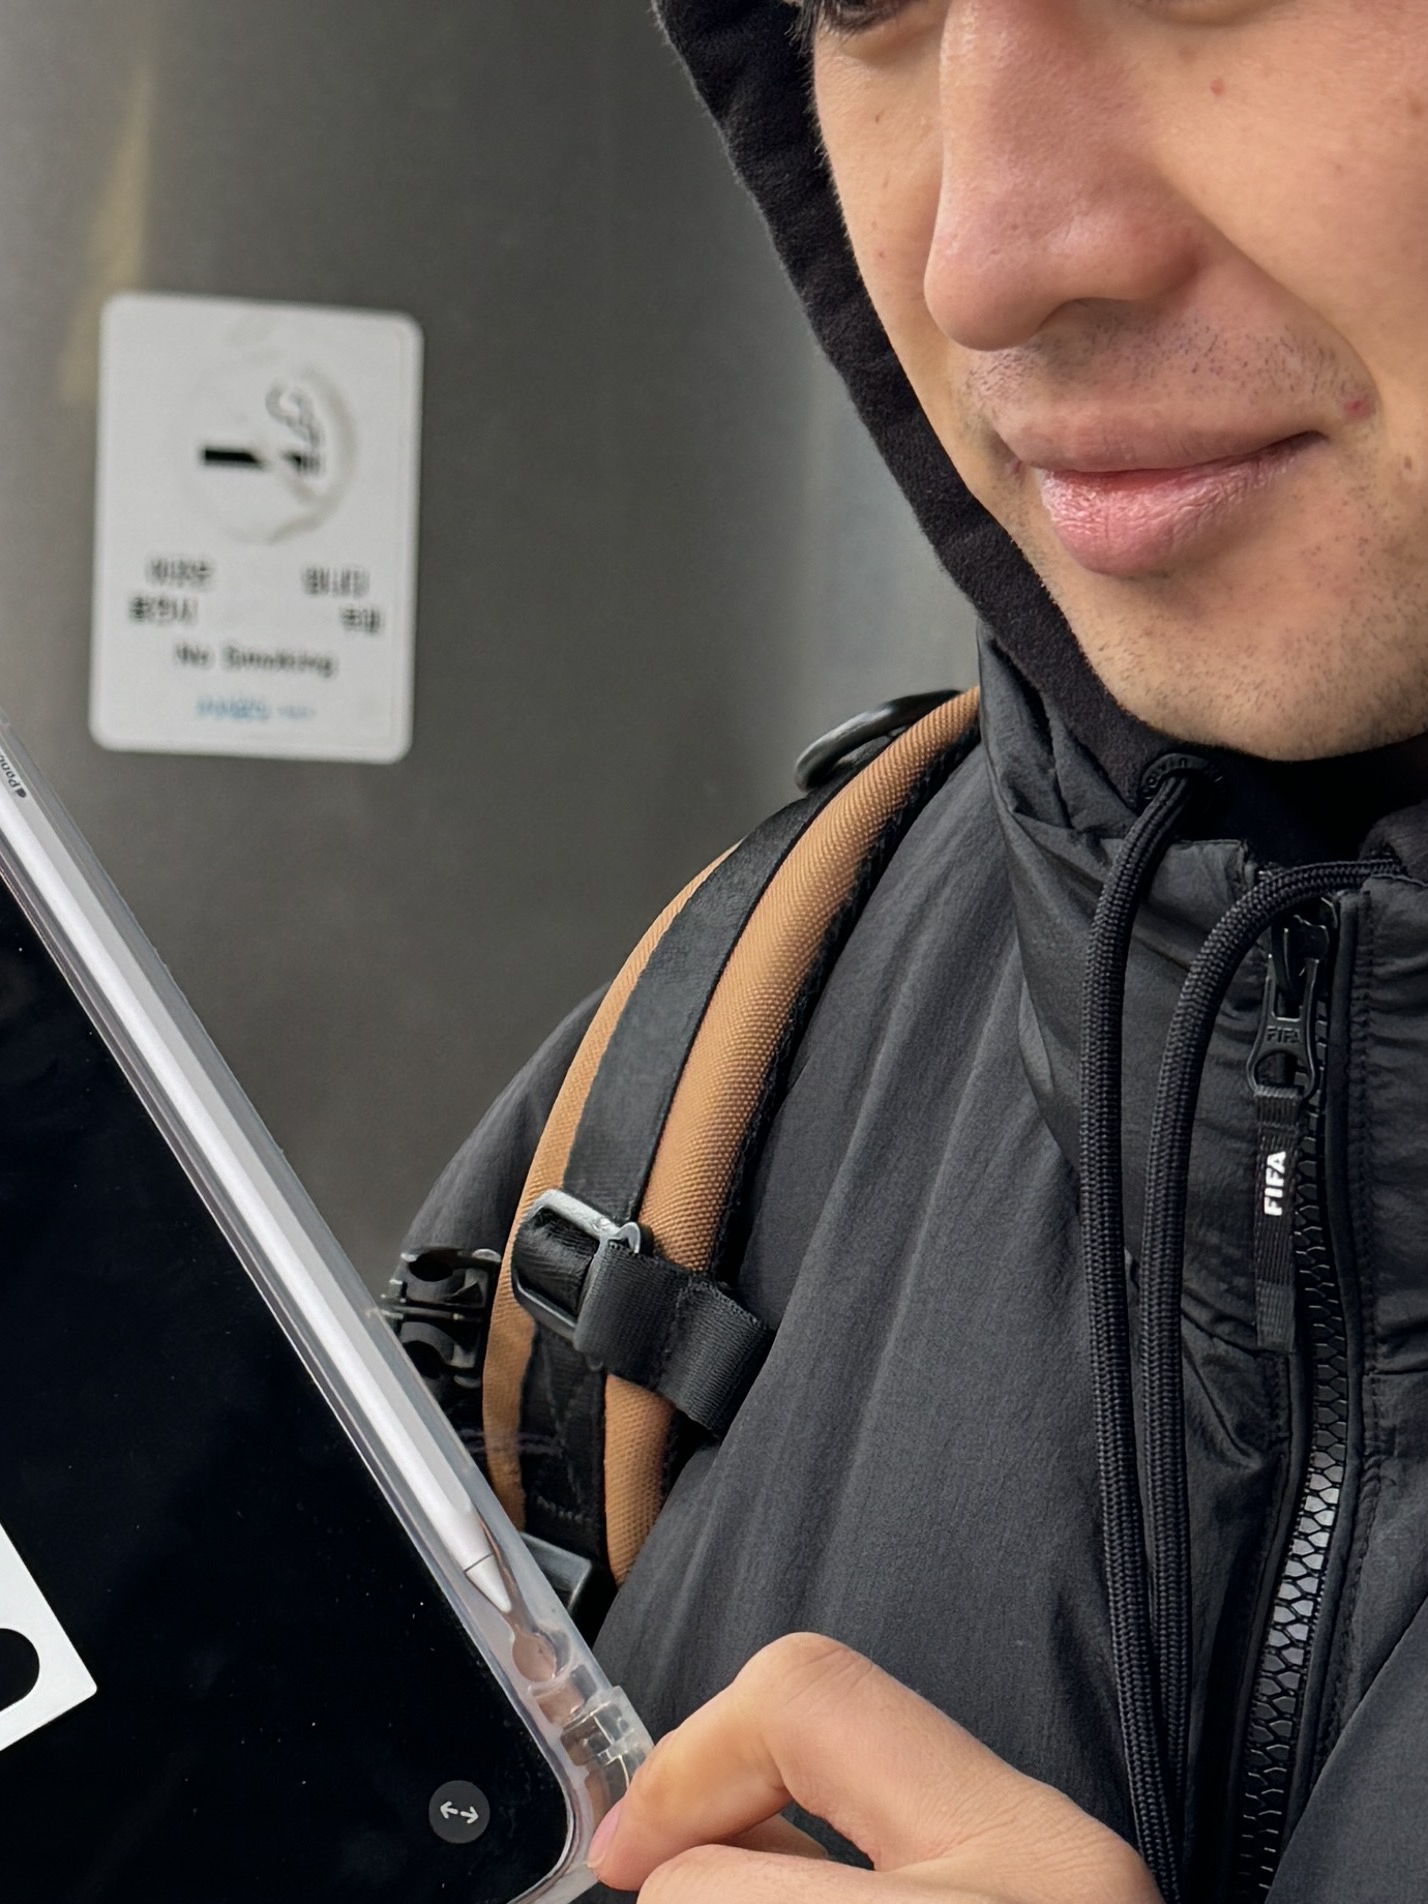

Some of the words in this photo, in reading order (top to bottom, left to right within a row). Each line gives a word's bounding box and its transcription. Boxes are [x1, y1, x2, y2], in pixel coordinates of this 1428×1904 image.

[176, 644, 210, 667] No
[224, 646, 335, 677] Smoking
[1267, 1025, 1302, 1044] FIFA
[1263, 1151, 1287, 1216] FIFA
